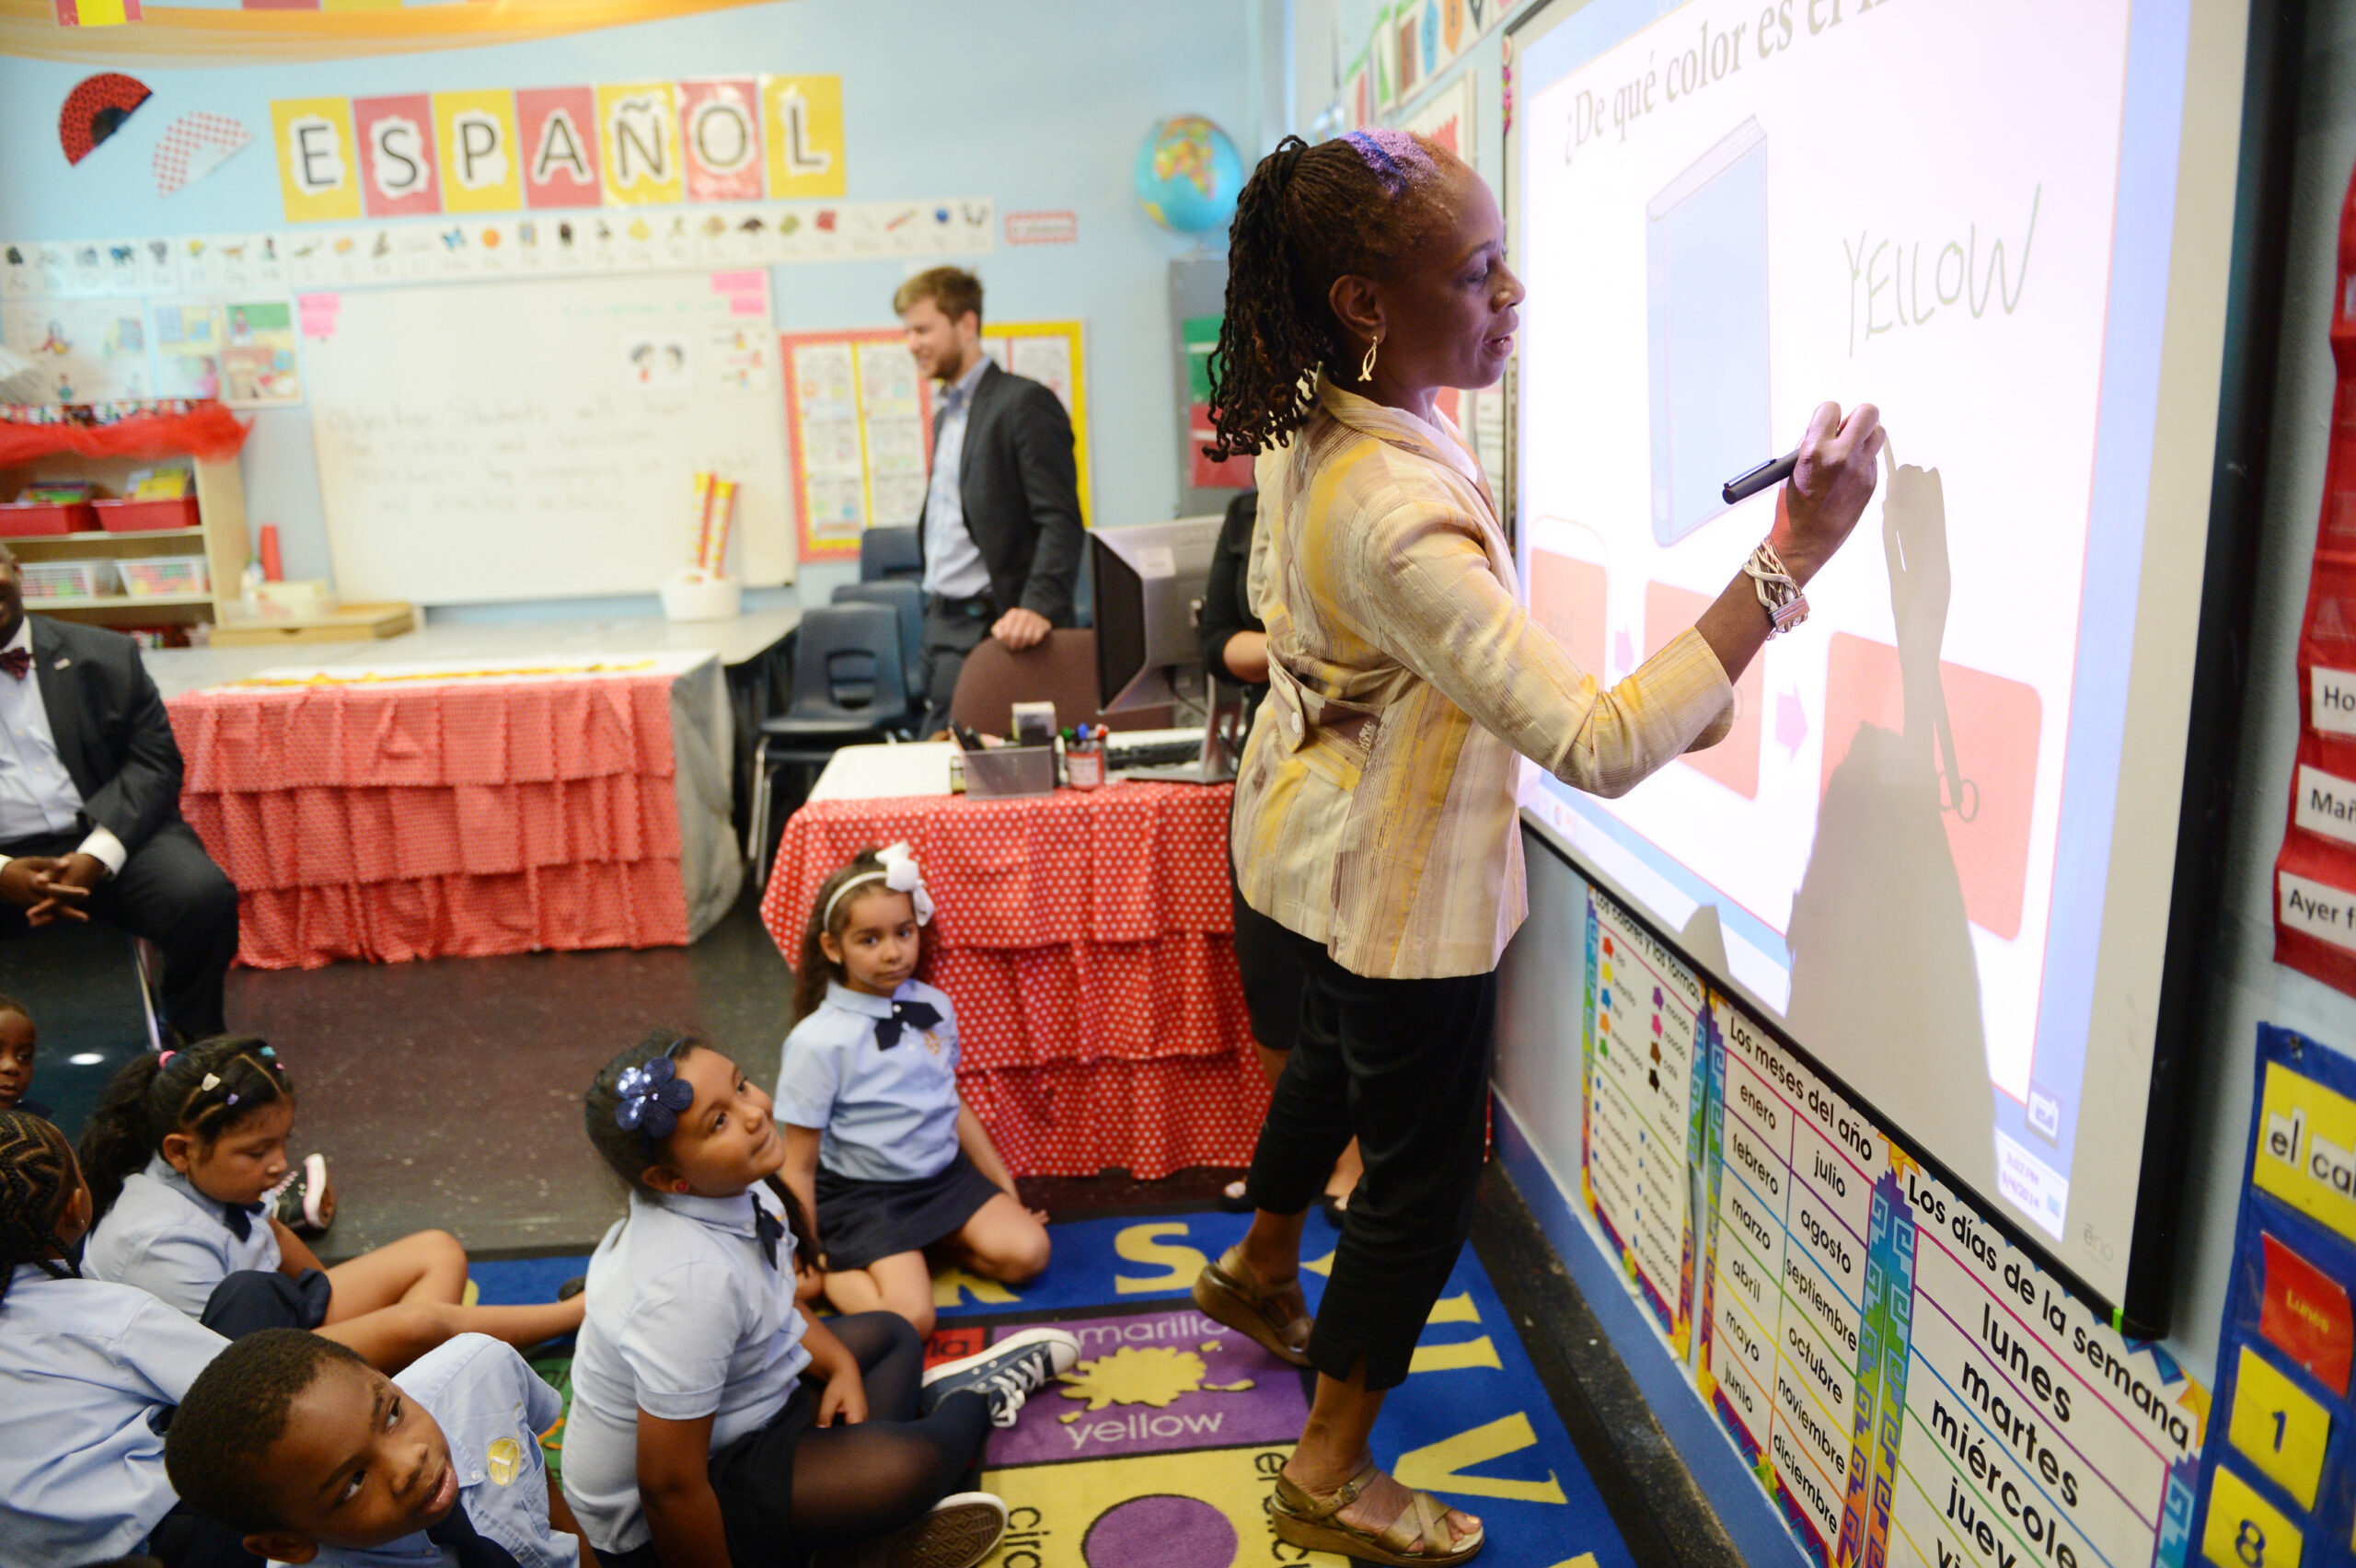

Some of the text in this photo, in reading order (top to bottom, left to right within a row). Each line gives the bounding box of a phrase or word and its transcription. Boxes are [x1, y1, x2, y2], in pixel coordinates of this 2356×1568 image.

[1613, 49, 1657, 144] qué
[1666, 18, 1747, 103] color
[1757, 0, 1795, 60] es
[295, 100, 827, 197] ESPAÑOL
[1842, 181, 2040, 358] YELLOW
[2289, 888, 2339, 922] Ayer
[1730, 1016, 1873, 1161] Los meses del año
[1740, 1084, 1776, 1131] enero
[1733, 1133, 1779, 1195] febrero
[2270, 1118, 2299, 1163] el
[1814, 1150, 1846, 1198] julio
[1732, 1197, 1771, 1250] marzo
[1801, 1209, 1852, 1274] agosto
[1732, 1260, 1761, 1303] abril
[1786, 1258, 1857, 1352] septiembre
[1909, 1174, 2189, 1450] Los días de la semana
[1061, 1315, 1230, 1347] marillo
[1727, 1309, 1760, 1362] mayo
[1724, 1362, 1753, 1413] junio
[1788, 1327, 1843, 1404] octubre
[1981, 1302, 2072, 1423] lunes
[1064, 1412, 1225, 1450] yellow
[1778, 1376, 1846, 1475] noviembre
[1961, 1361, 2078, 1507] martes
[2271, 1410, 2287, 1454] 1
[1773, 1434, 1838, 1535] diciembre
[2235, 1518, 2267, 1568] 8
